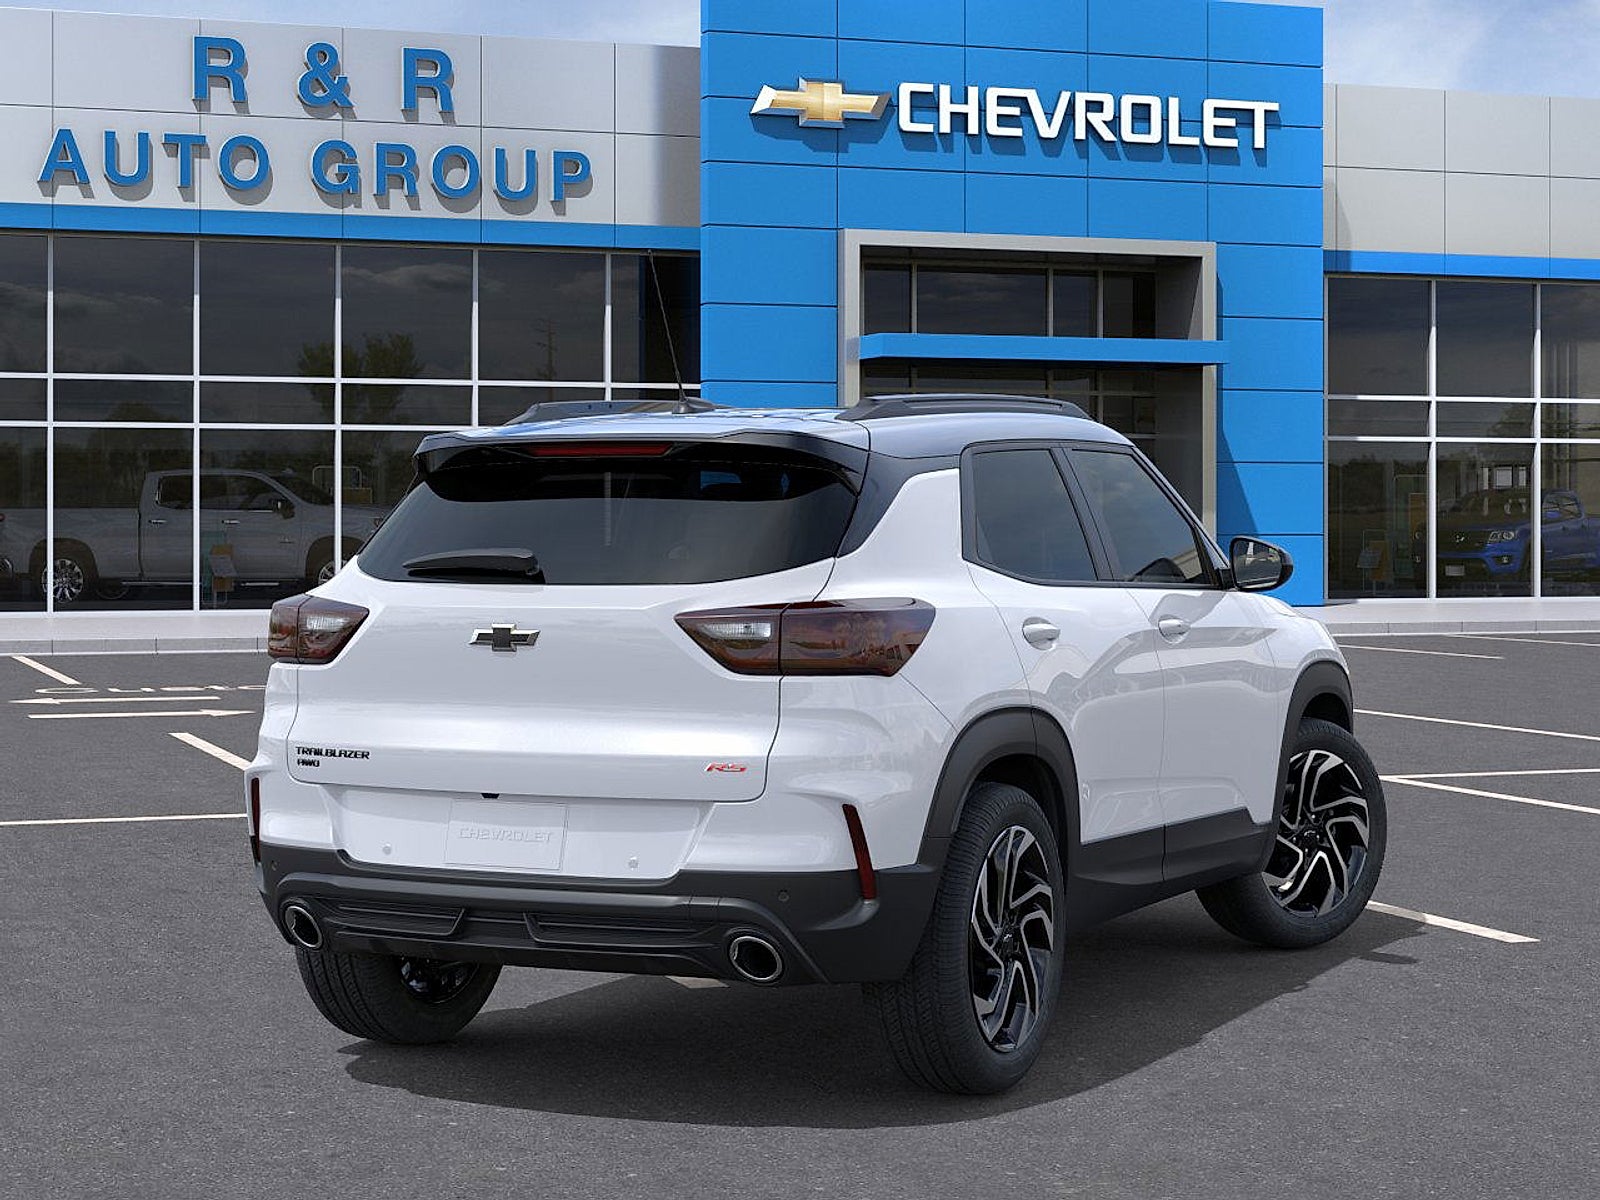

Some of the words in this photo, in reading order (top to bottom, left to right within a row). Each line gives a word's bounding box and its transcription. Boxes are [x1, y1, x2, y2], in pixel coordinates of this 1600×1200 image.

[191, 36, 248, 103] R
[298, 41, 353, 108] &
[401, 47, 455, 113] R
[898, 82, 1280, 150] CHEVROLET
[38, 128, 269, 191] AUTO
[311, 139, 591, 202] GROUP
[295, 746, 370, 759] TRAILBLAZER
[297, 759, 320, 767] AWD
[705, 762, 747, 772] RS
[459, 827, 553, 842] CHEVROLET
